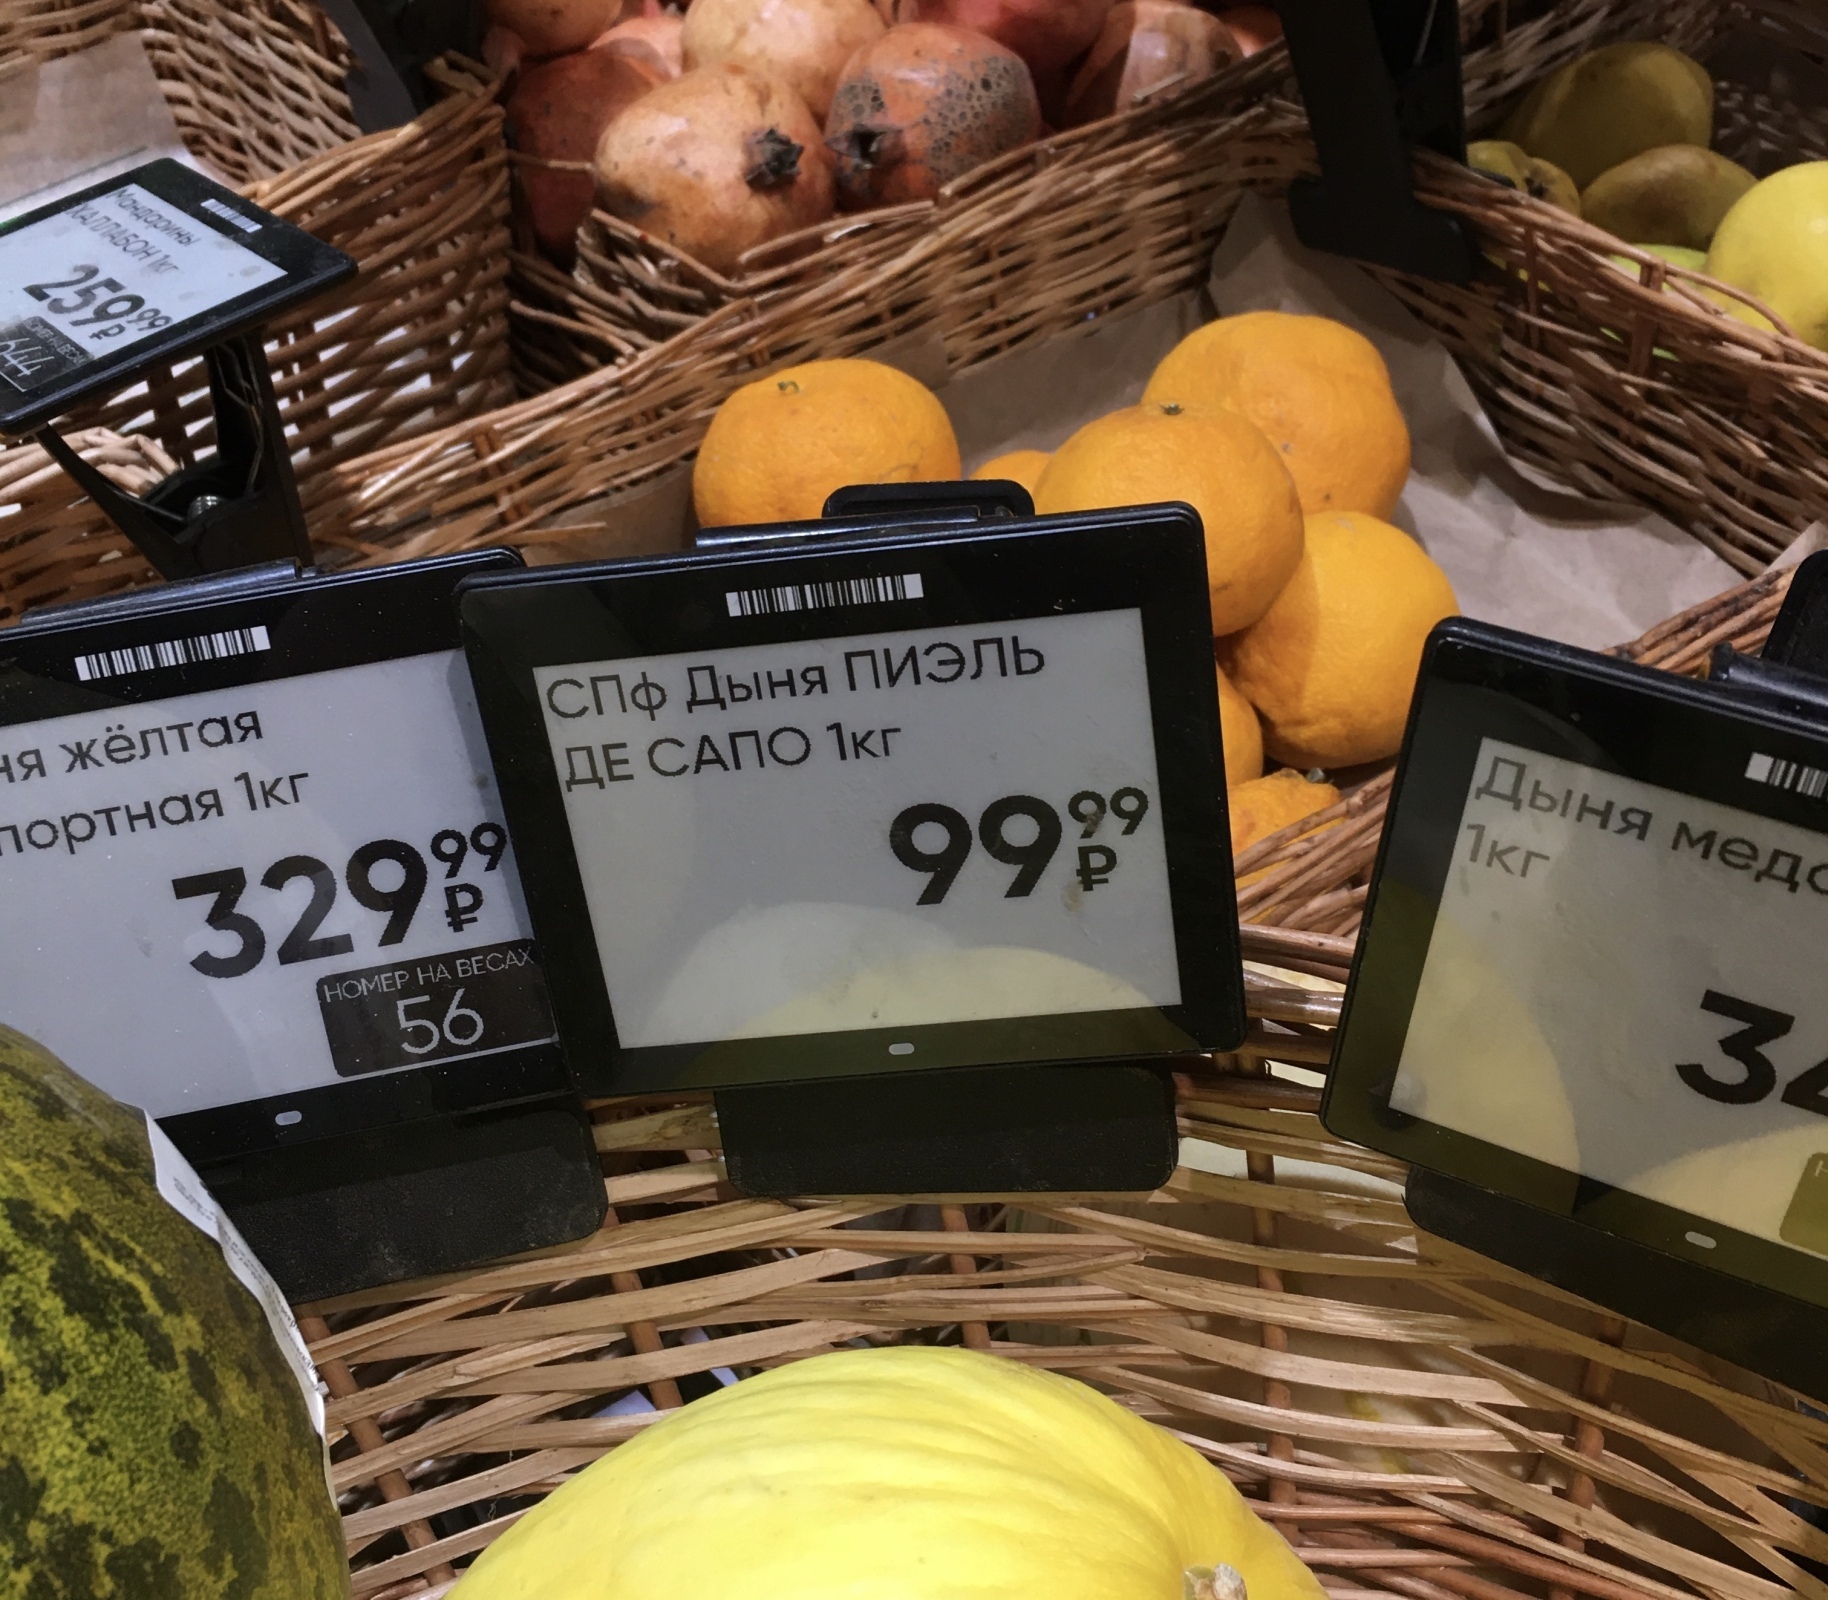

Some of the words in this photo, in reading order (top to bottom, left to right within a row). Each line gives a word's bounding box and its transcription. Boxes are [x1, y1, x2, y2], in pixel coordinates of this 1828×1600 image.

[23, 264, 146, 327] 259
[126, 308, 173, 332] 99
[547, 674, 667, 721] СПф
[686, 664, 828, 713] Дыня
[844, 635, 1045, 687] ПИЭЛЬ
[58, 710, 263, 773] жёлтая
[565, 743, 634, 792] ДЕ
[648, 726, 811, 778] САПО
[826, 722, 901, 762] 1кг
[233, 772, 309, 812] 1кг
[1475, 755, 1653, 842] Дыня
[888, 794, 1062, 906] 99
[1068, 787, 1149, 839] 99
[1465, 823, 1551, 879] 1кг
[172, 838, 428, 979] 329
[430, 822, 507, 879] 99
[324, 969, 409, 1003] НОМЕР
[416, 962, 451, 986] НА
[456, 946, 534, 978] ВЕСАХ
[396, 987, 484, 1055] 56
